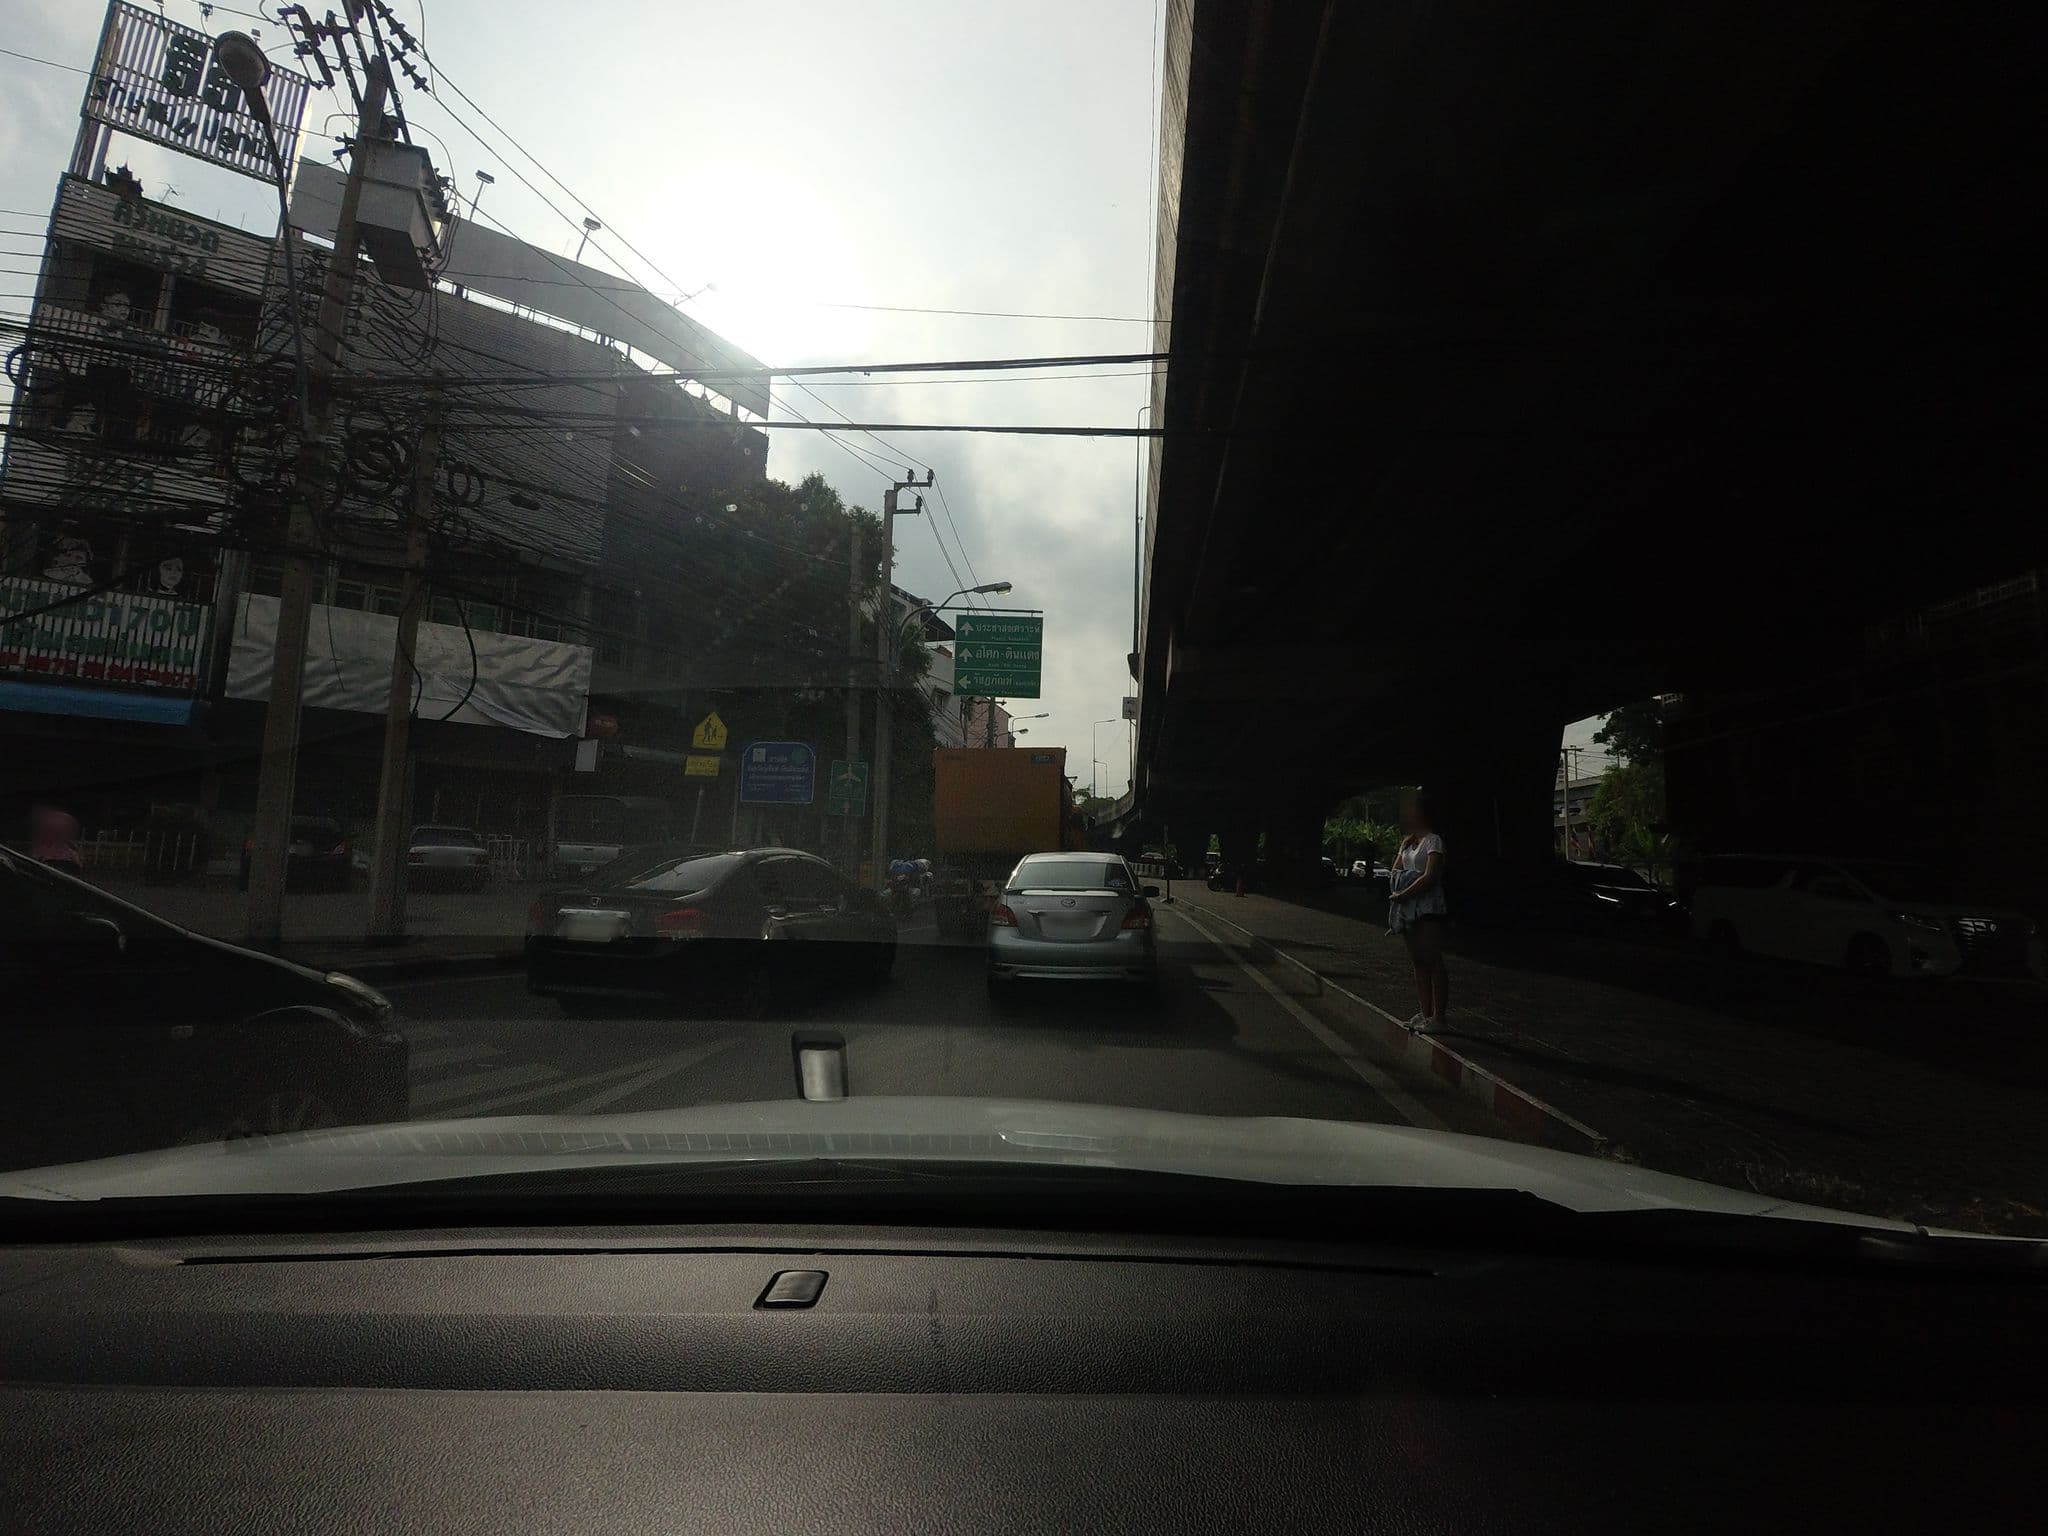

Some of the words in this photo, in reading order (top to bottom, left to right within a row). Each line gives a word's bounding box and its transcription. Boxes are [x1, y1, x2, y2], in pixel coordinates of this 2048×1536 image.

[975, 646, 1000, 659] อโศก
[1005, 646, 1040, 660] ดินแดง
